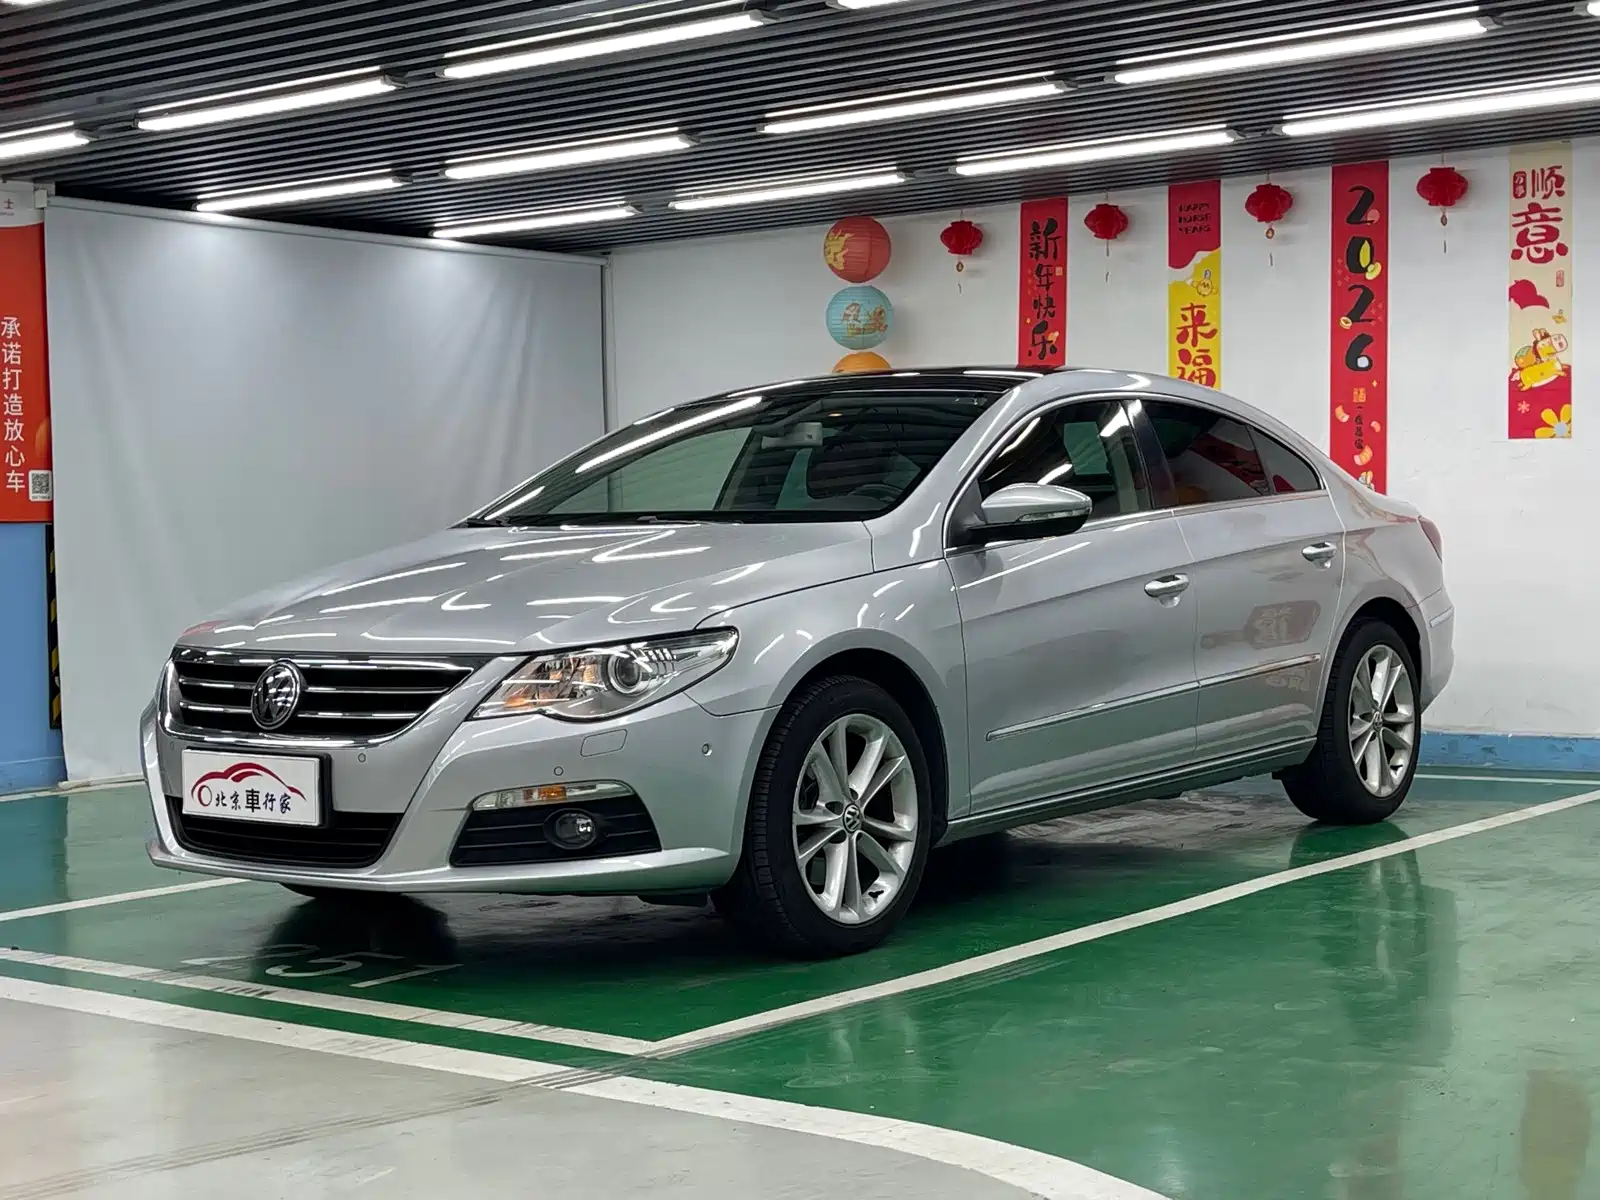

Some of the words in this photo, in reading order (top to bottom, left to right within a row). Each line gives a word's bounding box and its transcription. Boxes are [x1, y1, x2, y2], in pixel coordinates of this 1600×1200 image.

[1028, 217, 1062, 360] 新年快乐
[1344, 185, 1376, 373] 2026
[1, 316, 25, 493] 承诺打造放心车
[215, 788, 292, 814] 北京車行家
